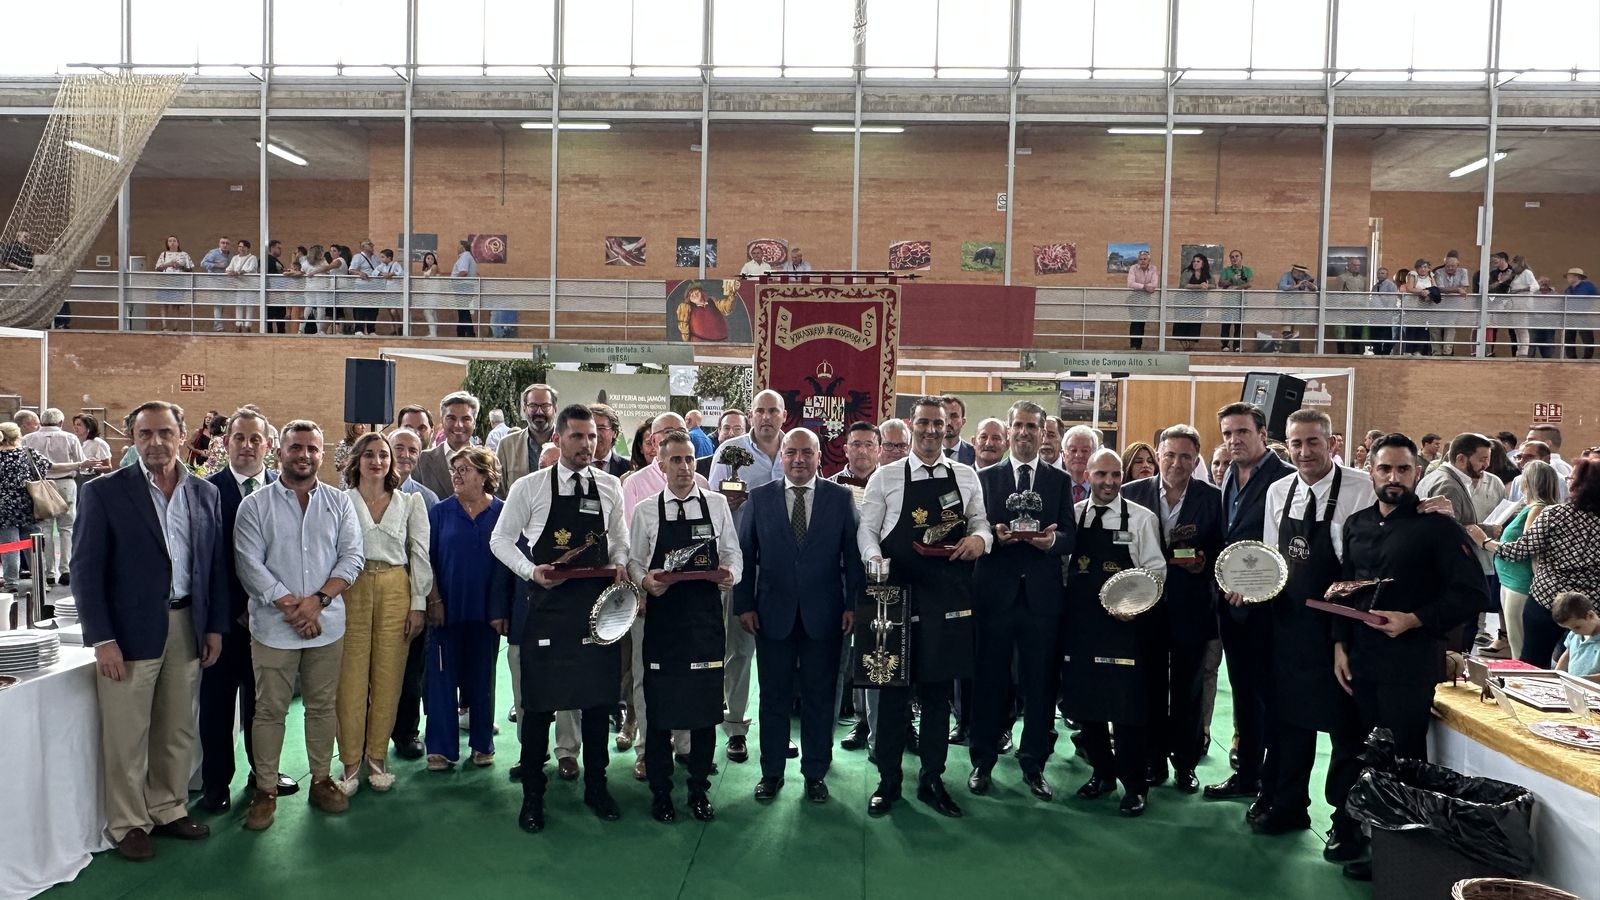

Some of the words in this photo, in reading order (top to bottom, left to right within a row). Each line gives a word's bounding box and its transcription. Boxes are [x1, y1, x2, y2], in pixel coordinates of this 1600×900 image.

[862, 312, 875, 346] 2004
[1063, 357, 1090, 366] Dehesa
[1091, 358, 1100, 366] de
[1102, 358, 1127, 367] Campo
[621, 394, 637, 402] FERIA
[646, 394, 666, 403] JAMÓN
